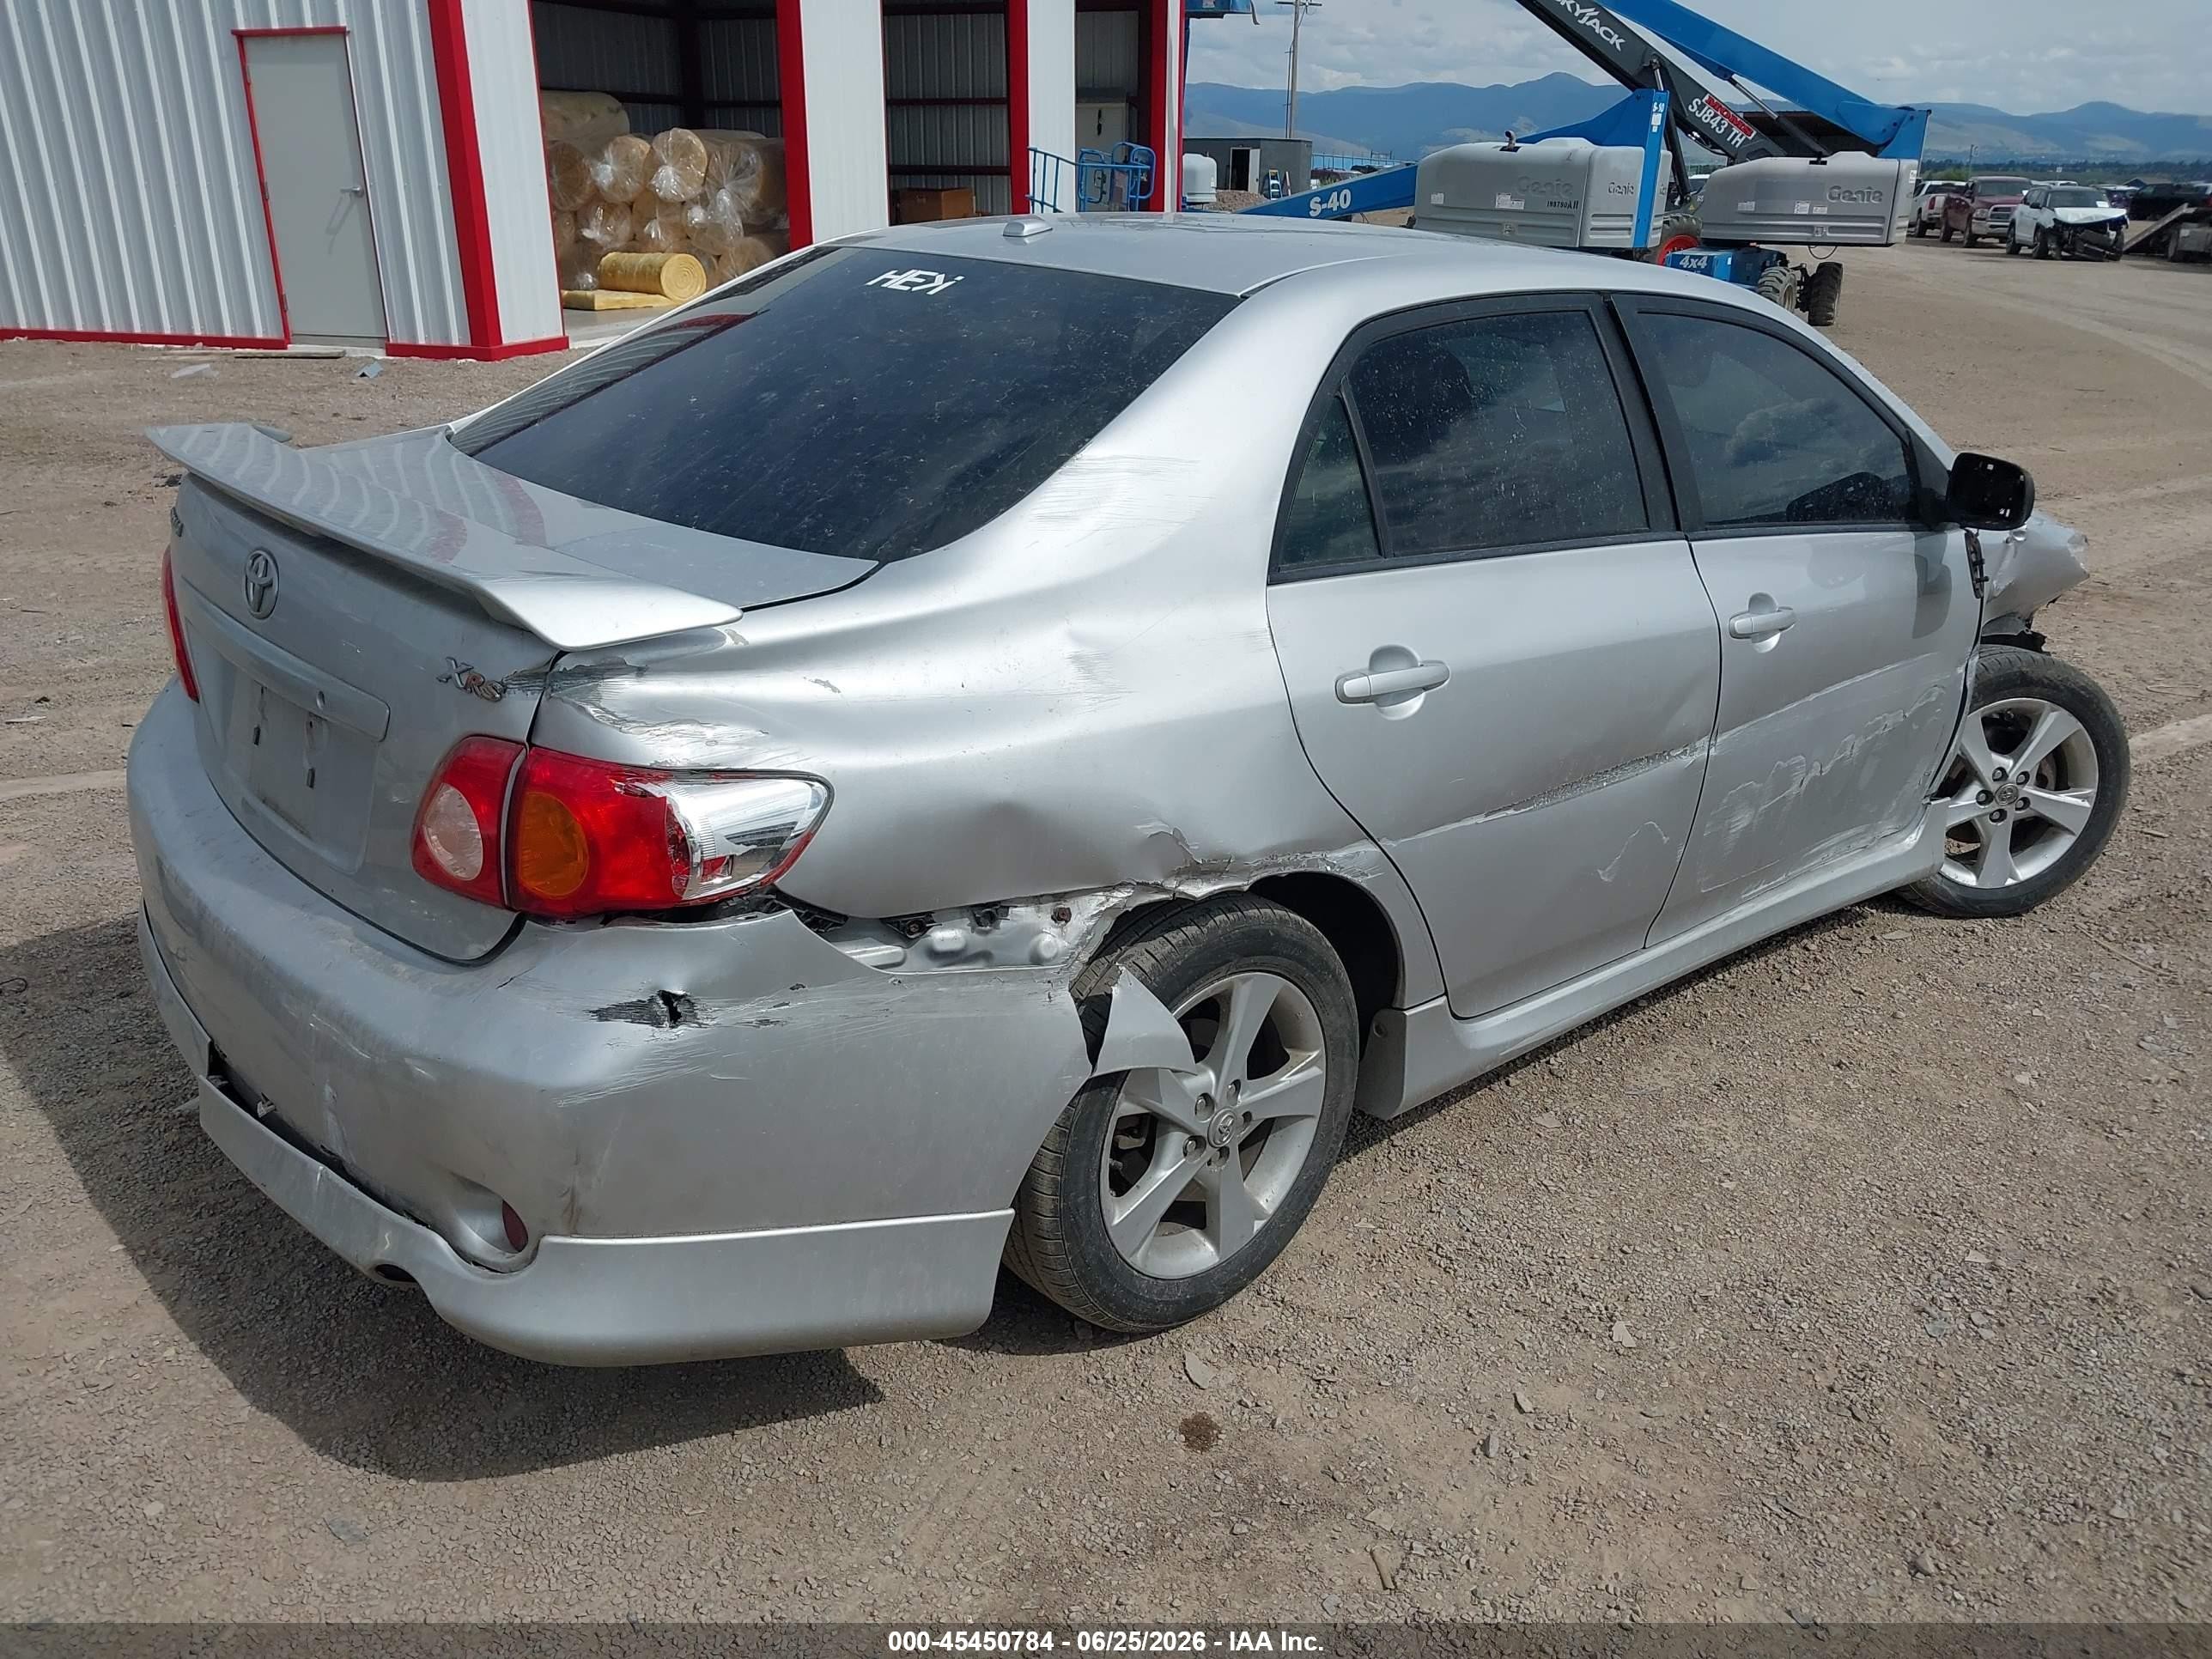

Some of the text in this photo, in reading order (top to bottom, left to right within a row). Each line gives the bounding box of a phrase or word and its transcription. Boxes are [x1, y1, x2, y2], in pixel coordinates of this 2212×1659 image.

[1688, 98, 1728, 134] SJ843
[1726, 127, 1746, 148] TH
[1309, 189, 1352, 217] S-40
[1826, 185, 1884, 204] Genie
[1679, 255, 1708, 269] 4x4
